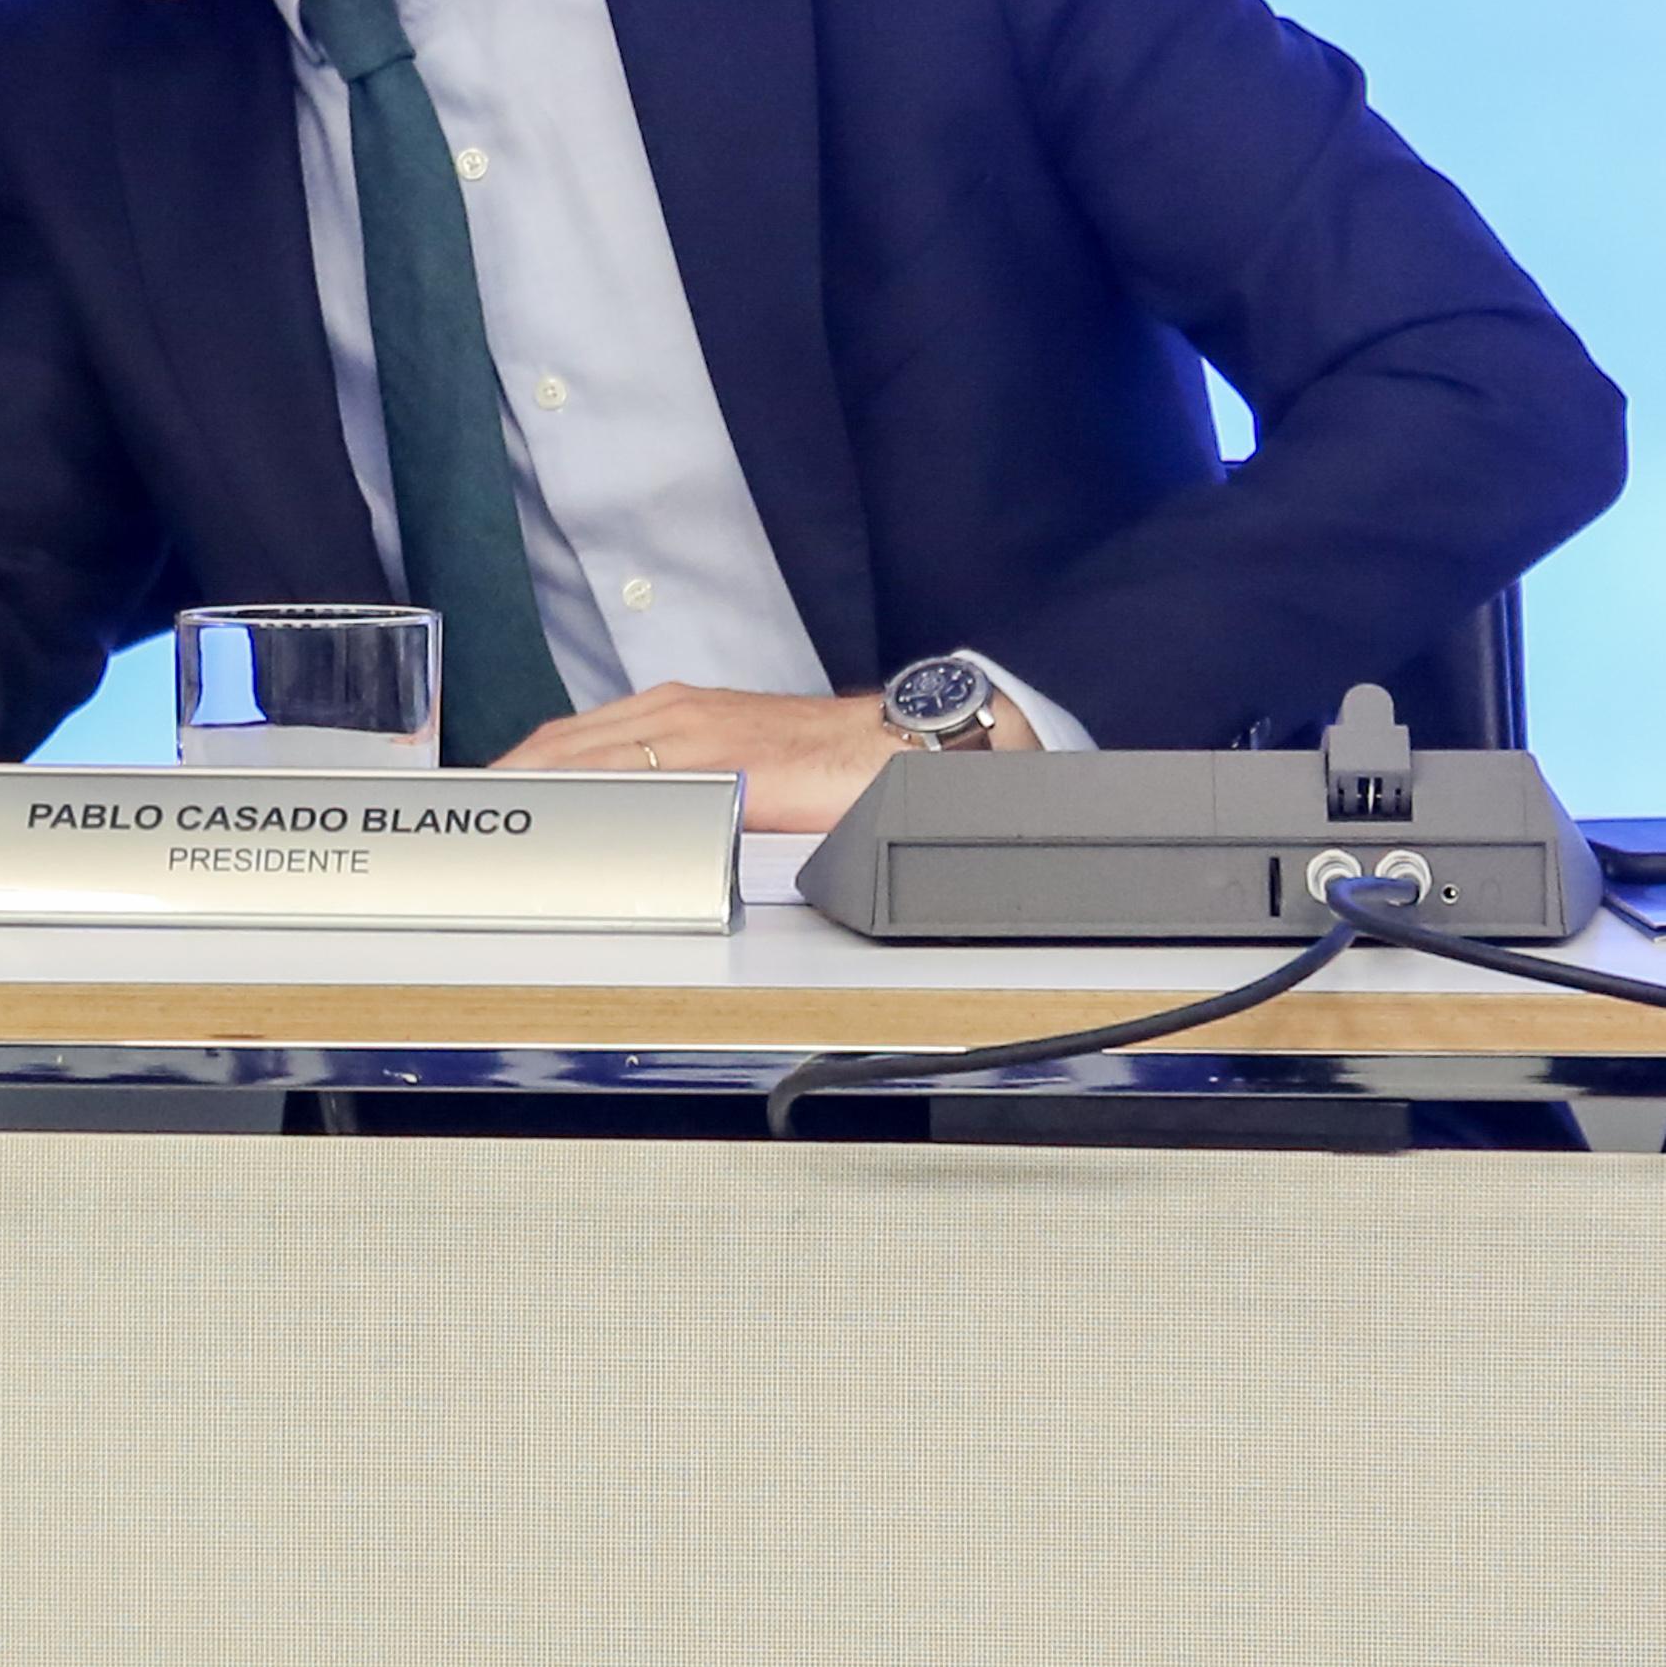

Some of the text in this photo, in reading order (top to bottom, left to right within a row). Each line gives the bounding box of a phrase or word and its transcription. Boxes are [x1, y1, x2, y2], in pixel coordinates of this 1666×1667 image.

[27, 803, 532, 835] PABLO CASADO BLANCO
[168, 847, 370, 874] PRESIDENTE
